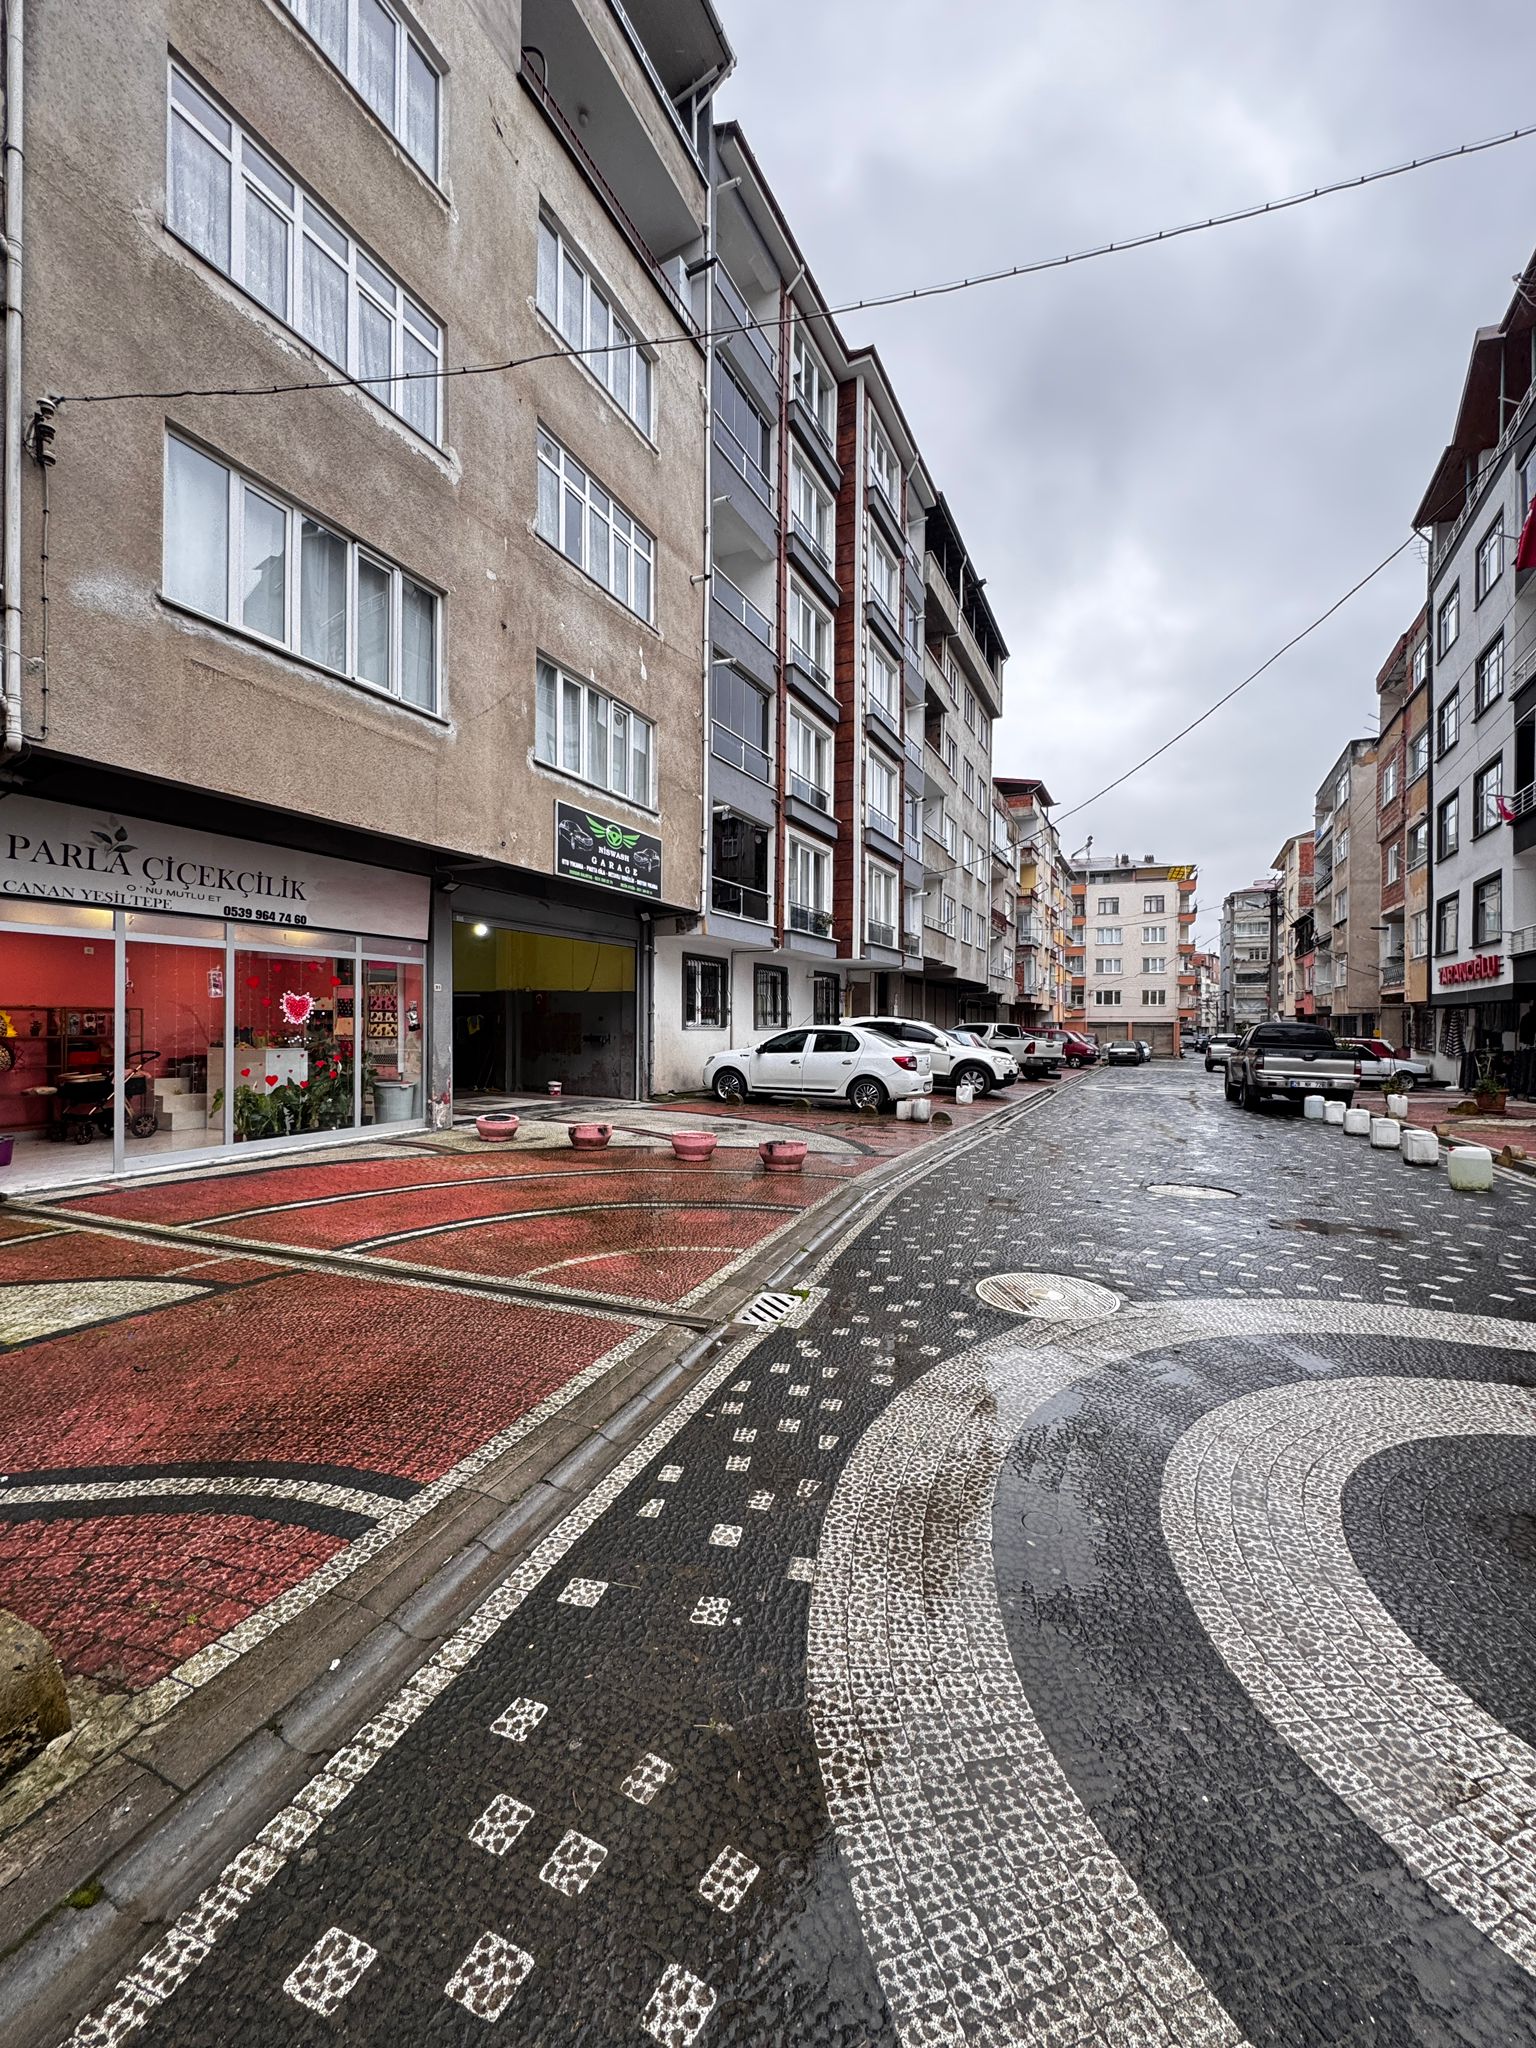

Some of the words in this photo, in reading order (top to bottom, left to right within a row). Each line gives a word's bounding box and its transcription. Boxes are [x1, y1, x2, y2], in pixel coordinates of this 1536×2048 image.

[5, 833, 132, 876] PARLA
[142, 856, 307, 900] ÇİÇEKÇİLİK
[591, 856, 638, 876] GARAGE
[3, 880, 74, 898] CANAN
[81, 889, 172, 909] YEŞİLTEPE
[166, 890, 206, 901] MUTLU
[224, 905, 252, 918] 0539
[255, 909, 275, 922] 964
[279, 912, 292, 923] 74
[294, 914, 307, 924] 60
